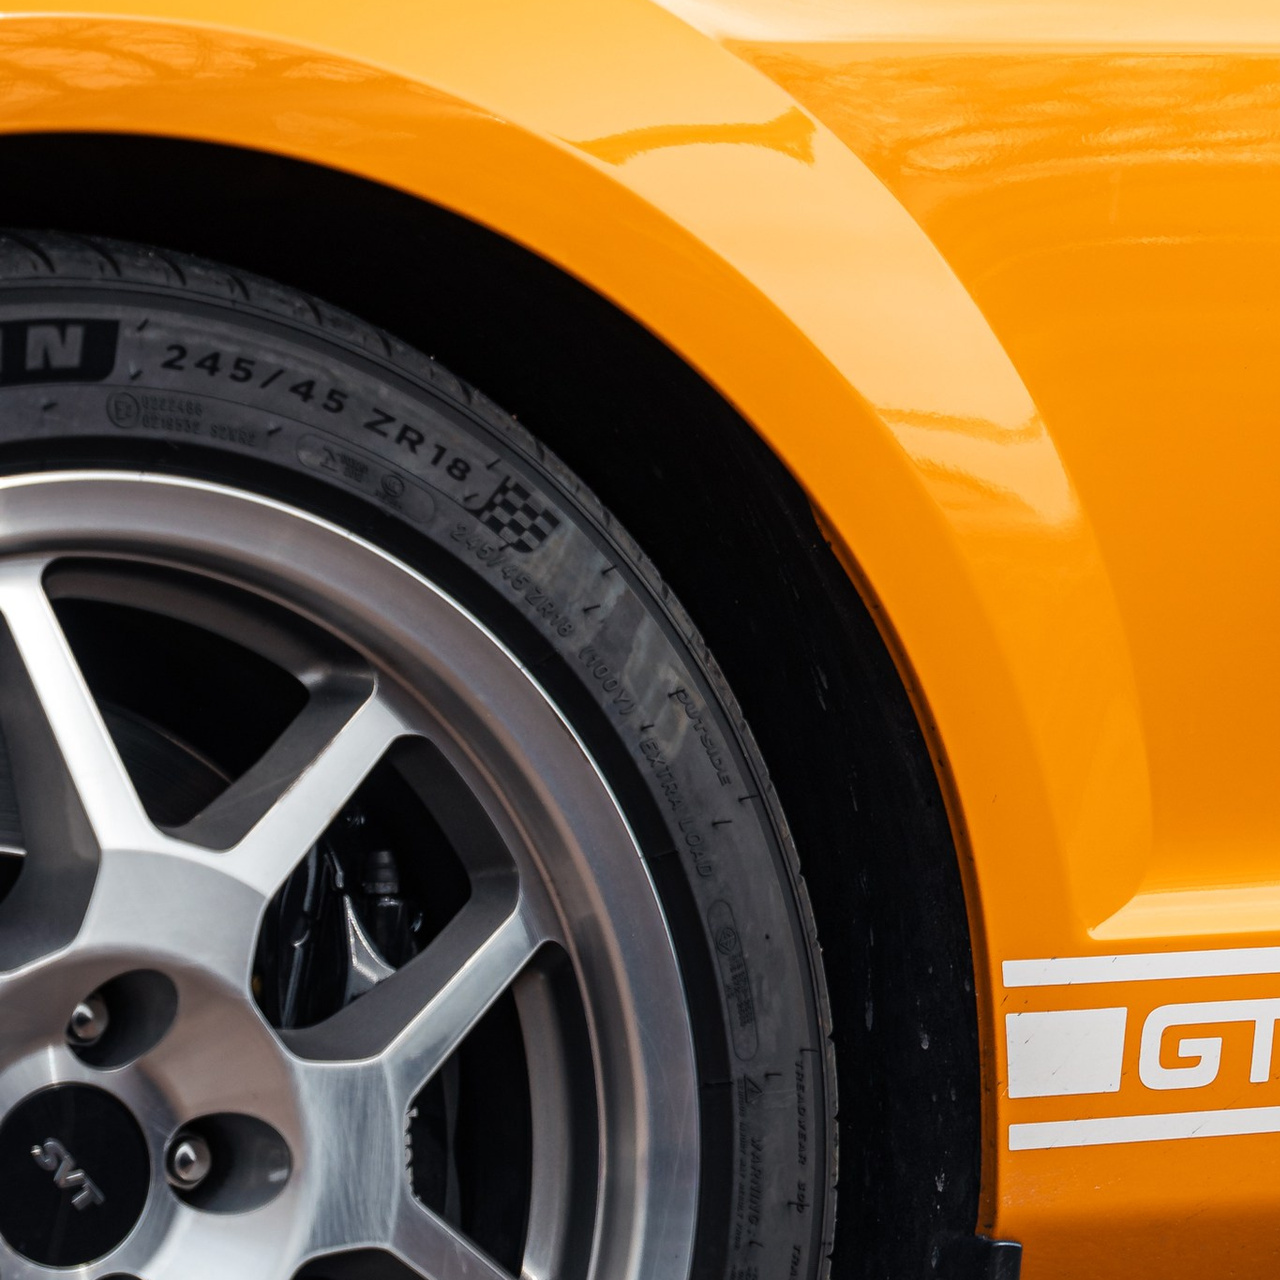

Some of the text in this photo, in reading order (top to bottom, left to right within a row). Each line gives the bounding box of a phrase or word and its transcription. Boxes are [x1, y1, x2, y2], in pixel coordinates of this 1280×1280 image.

[160, 343, 349, 414] 245/45
[363, 407, 472, 483] ZR18
[638, 736, 685, 812] EXTRA
[677, 817, 714, 879] LOAD
